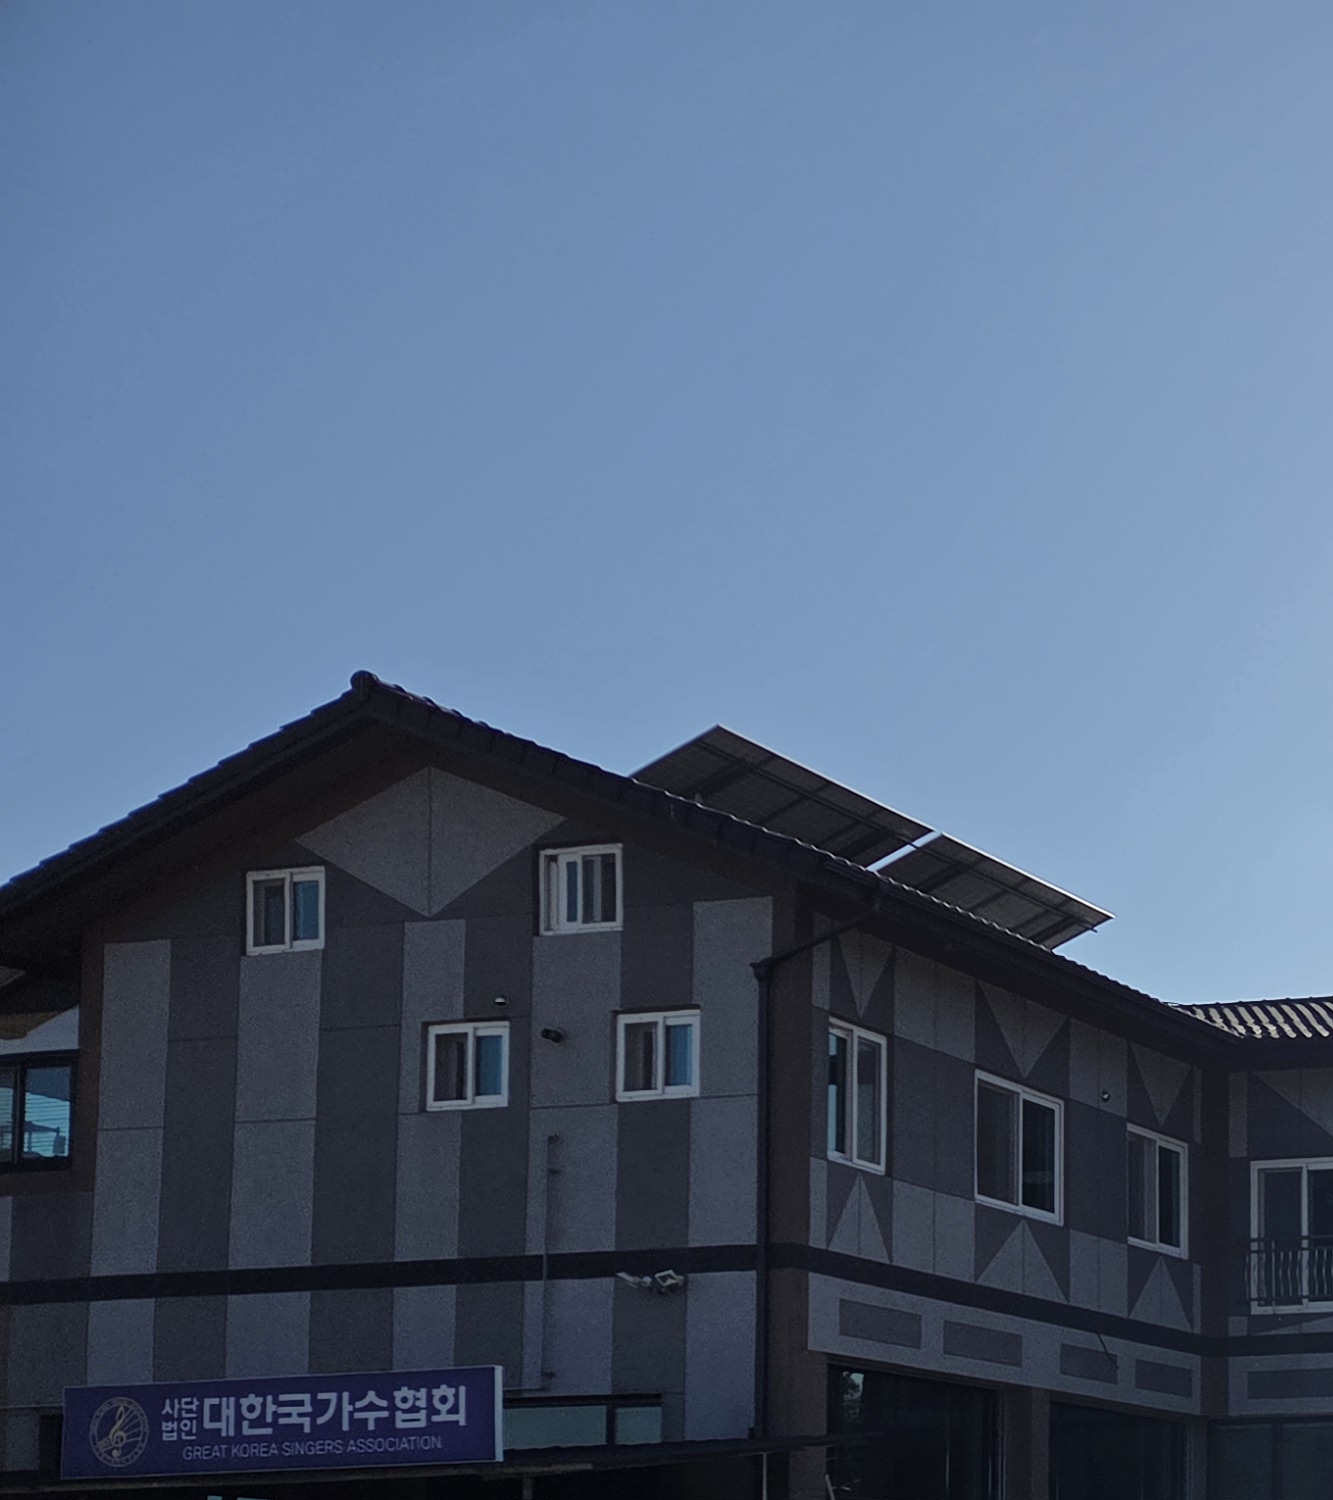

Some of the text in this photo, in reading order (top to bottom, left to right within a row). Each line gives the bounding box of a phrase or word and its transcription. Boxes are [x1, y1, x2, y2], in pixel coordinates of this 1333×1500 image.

[161, 1397, 200, 1419] 사단
[203, 1384, 467, 1437] 대한국가수협회
[161, 1419, 198, 1441] 법인
[182, 1435, 442, 1460] GREAT KOREA SINGERS ASSOCIATION
